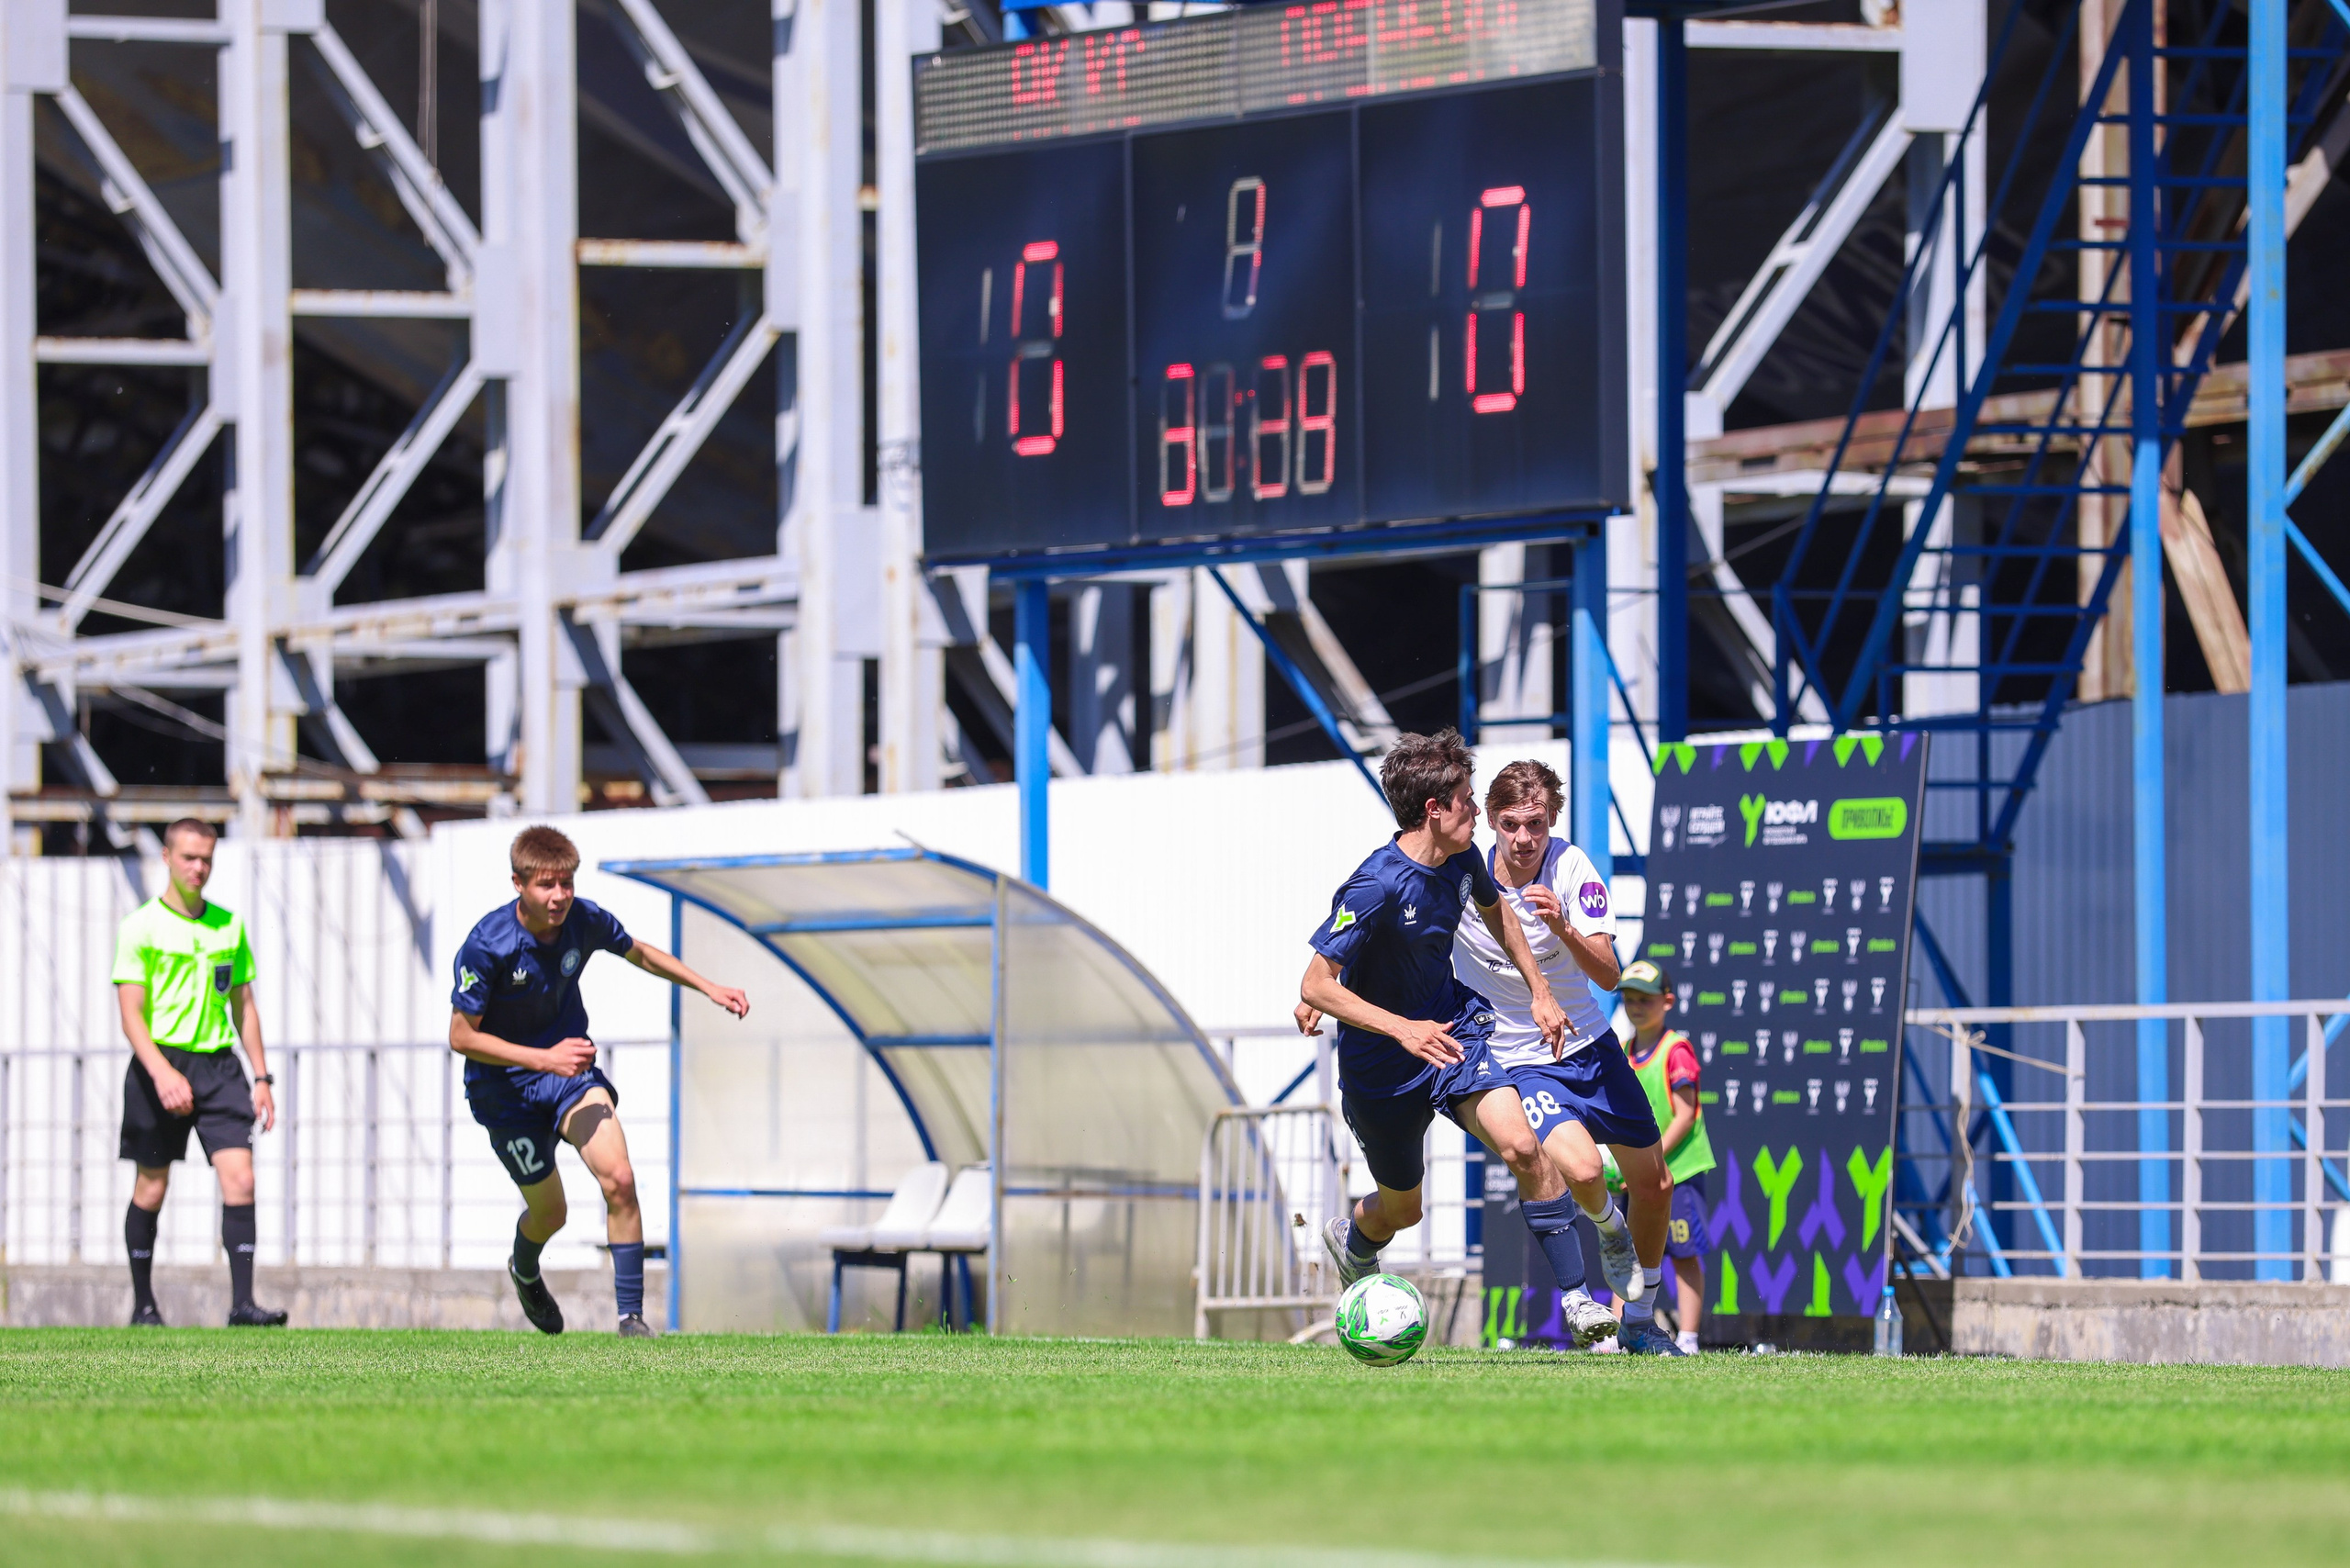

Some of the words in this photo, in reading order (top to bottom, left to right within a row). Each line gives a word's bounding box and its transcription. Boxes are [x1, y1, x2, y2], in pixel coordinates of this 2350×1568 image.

[1468, 185, 1531, 414] 0
[1008, 240, 1064, 457] 0
[1763, 799, 1819, 825] ЮФЛ
[1521, 1090, 1562, 1130] 88
[506, 1137, 544, 1176] 12
[1669, 1218, 1690, 1244] 19
